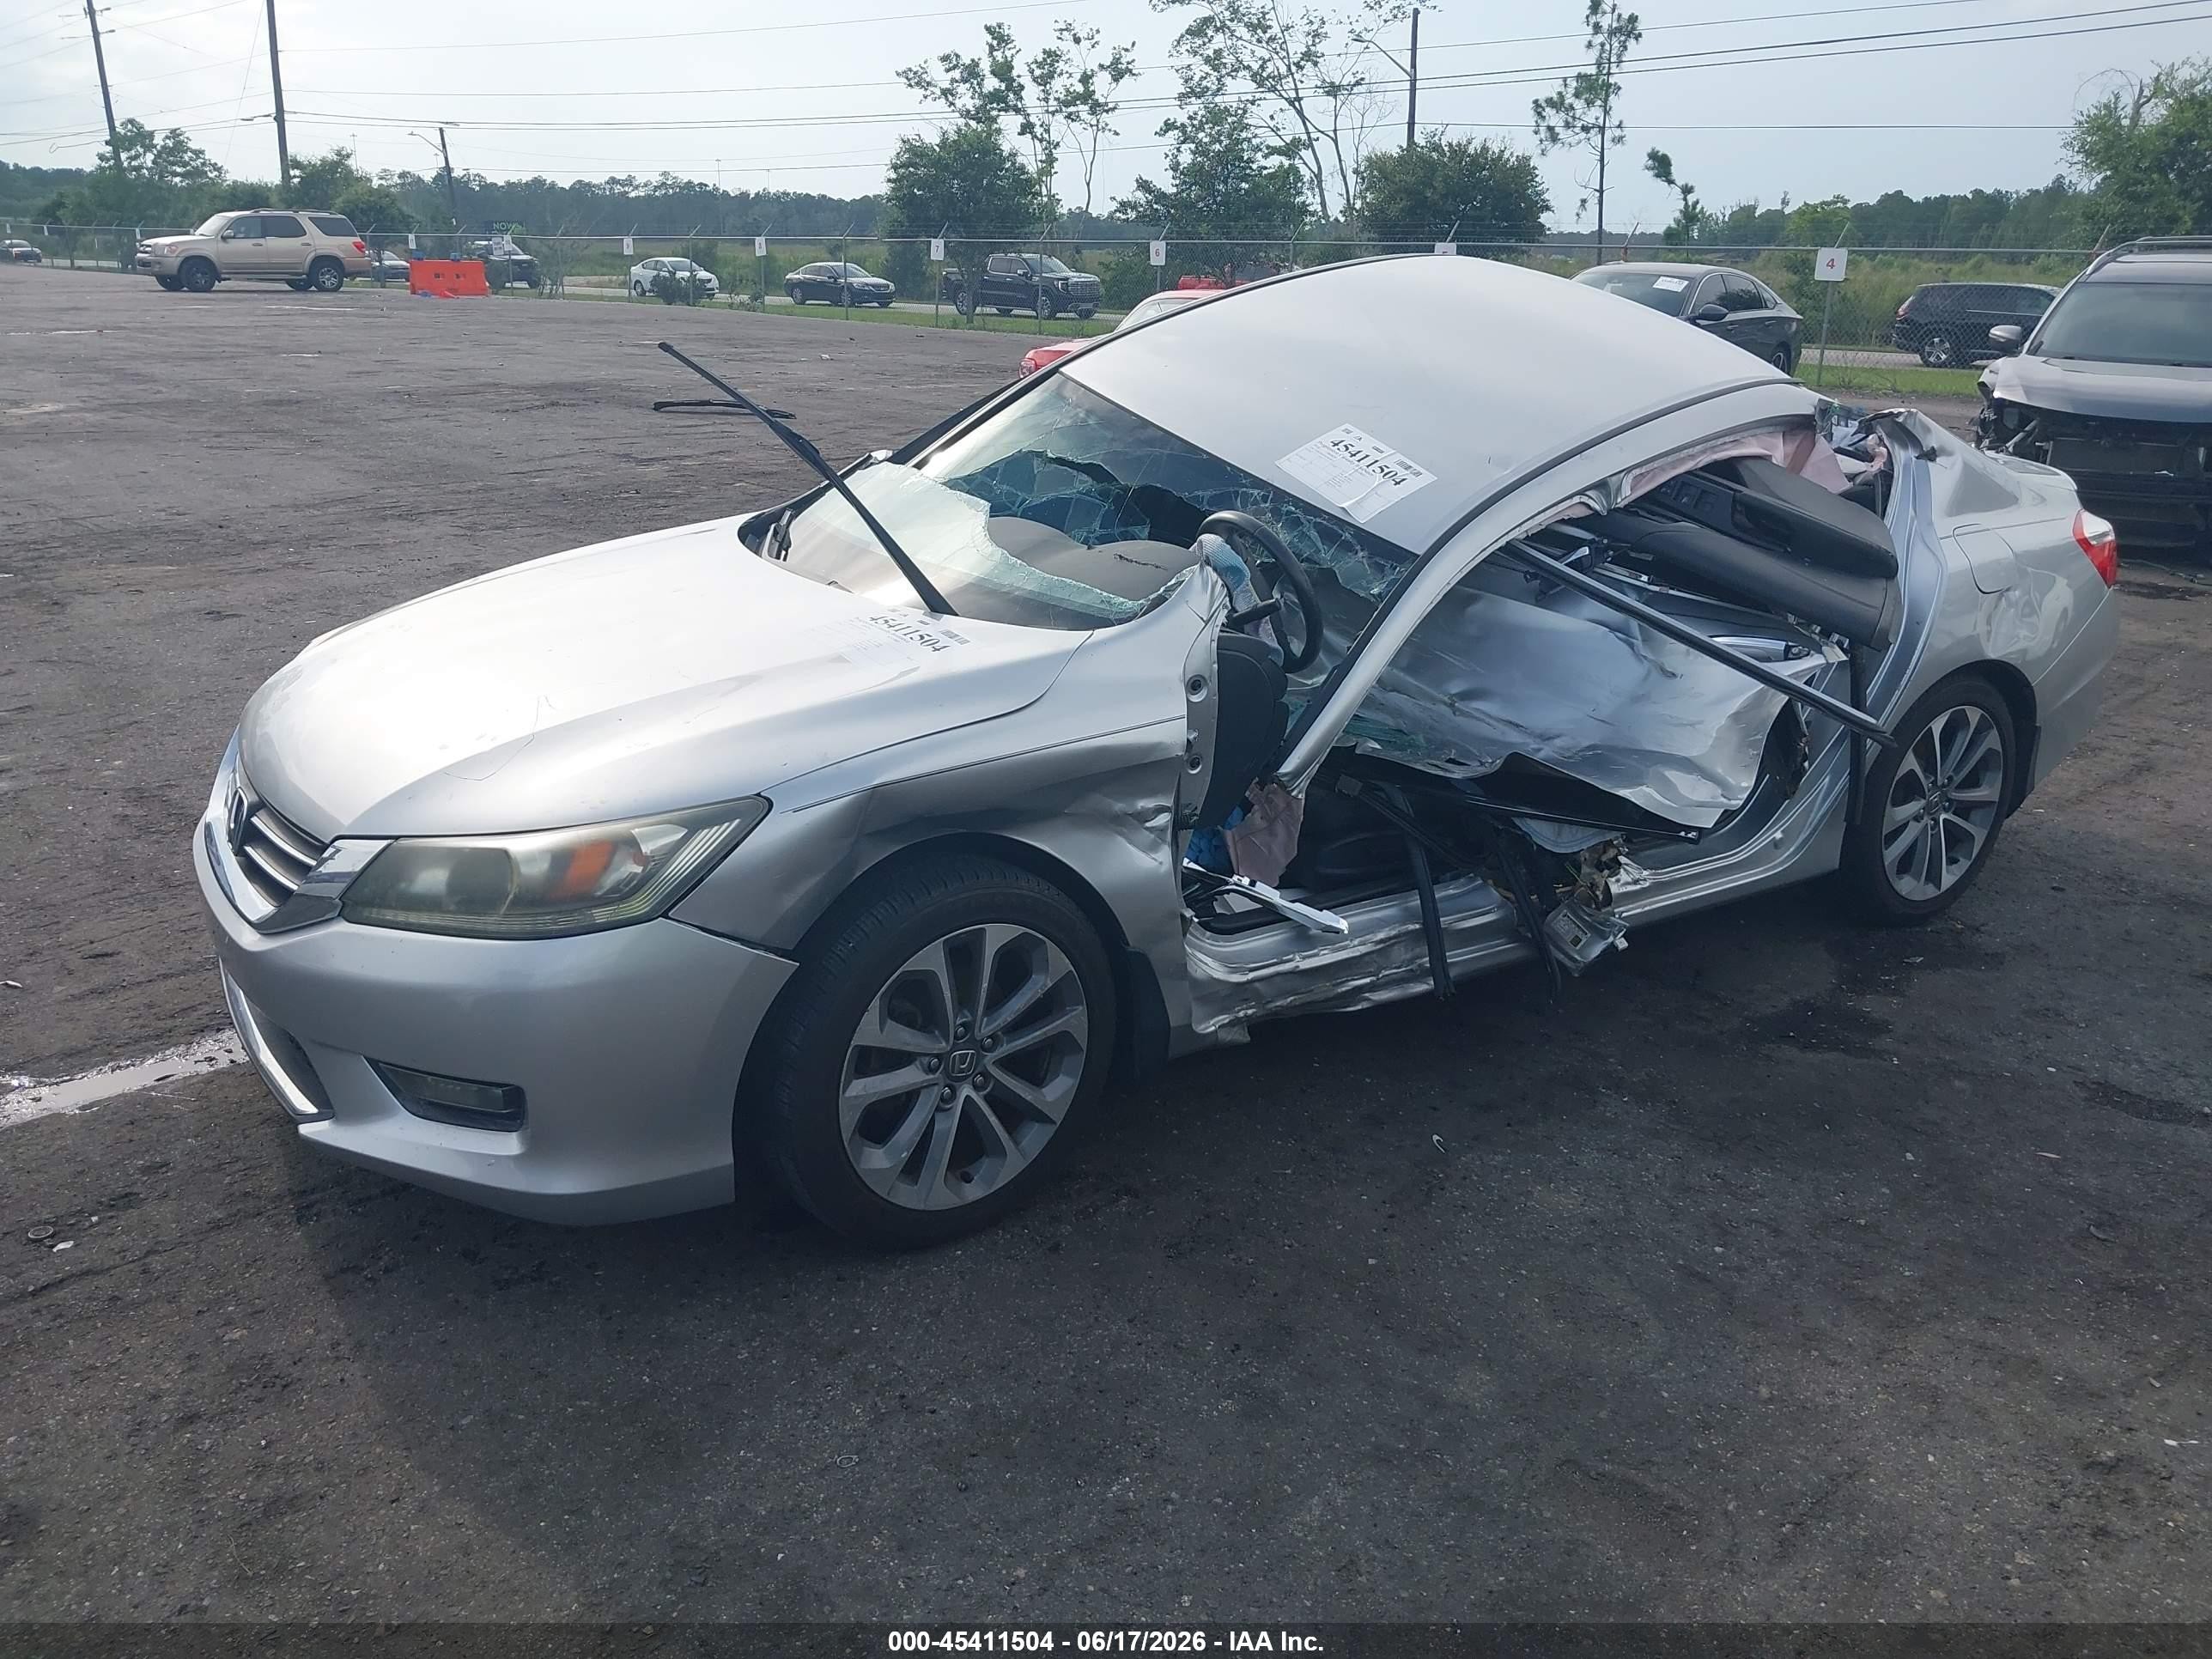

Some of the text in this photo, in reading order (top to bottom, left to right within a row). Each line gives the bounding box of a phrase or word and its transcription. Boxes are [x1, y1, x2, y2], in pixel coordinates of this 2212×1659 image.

[935, 245, 940, 253] 7
[1155, 248, 1160, 257] 6
[1826, 258, 1836, 270] 4
[1329, 439, 1408, 486] 45411504
[869, 616, 951, 653] 45411504
